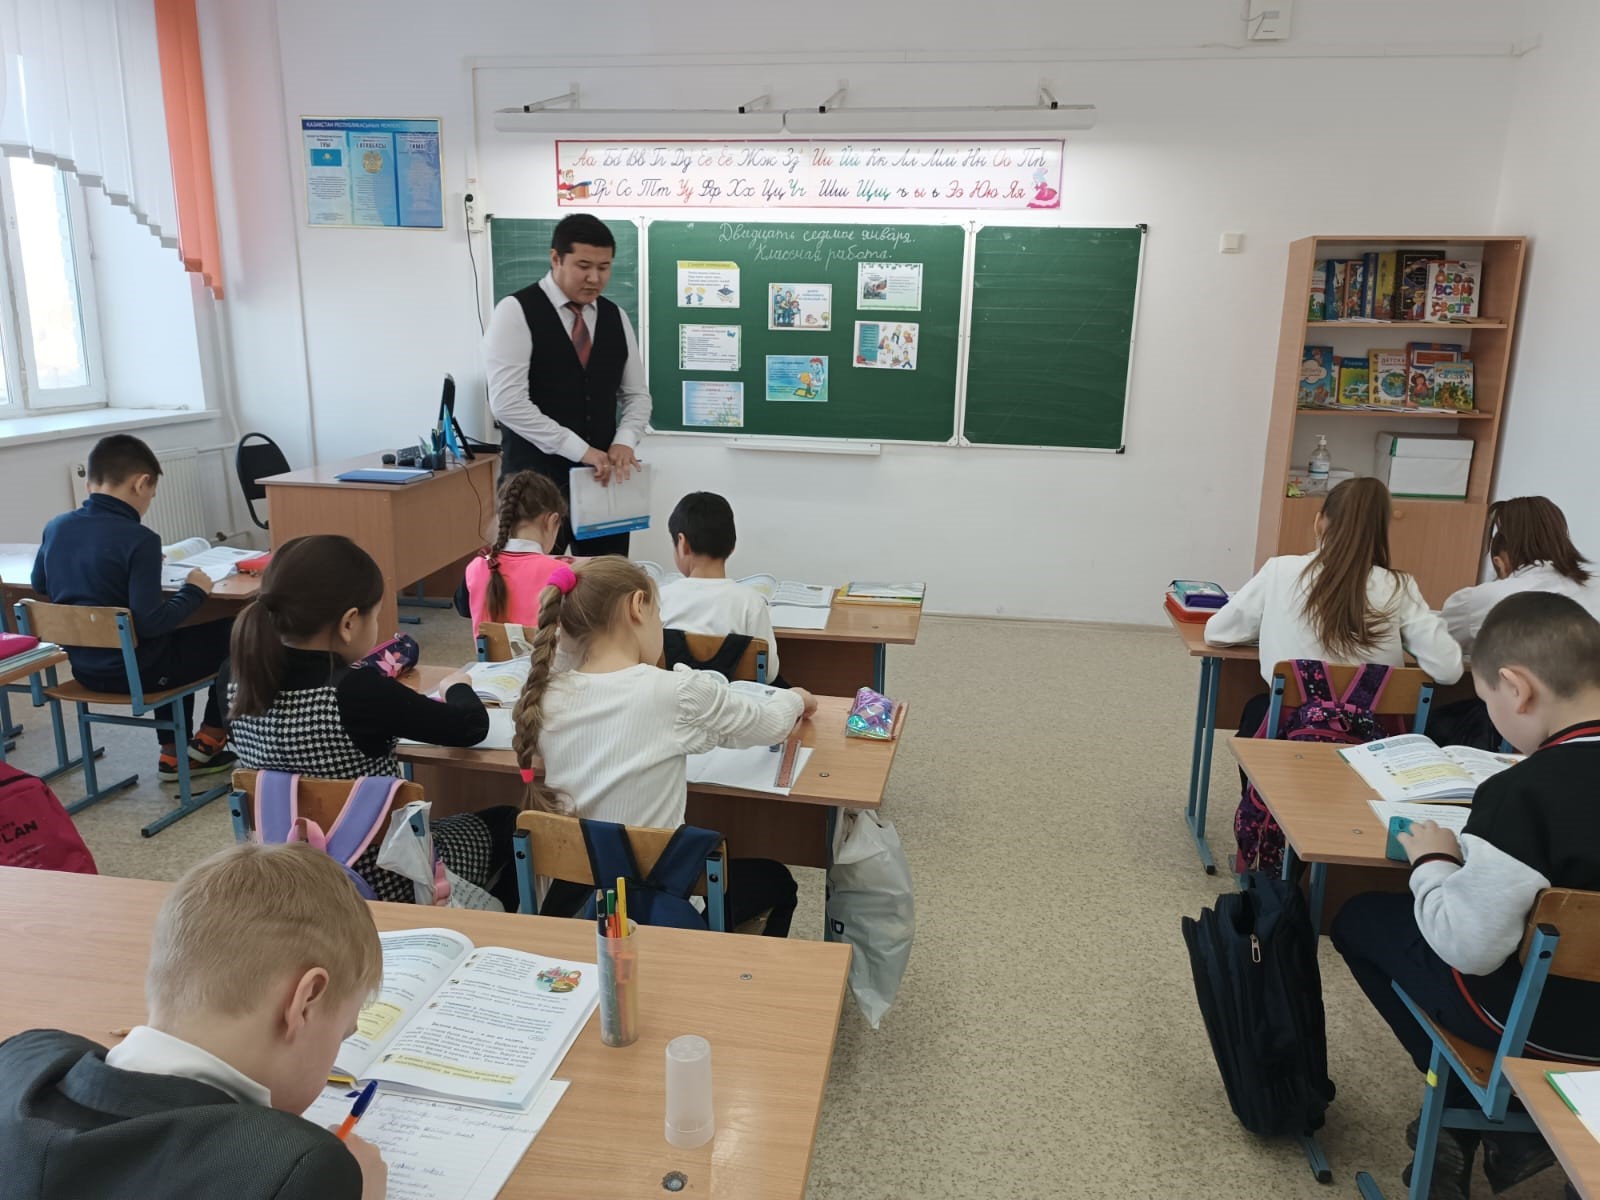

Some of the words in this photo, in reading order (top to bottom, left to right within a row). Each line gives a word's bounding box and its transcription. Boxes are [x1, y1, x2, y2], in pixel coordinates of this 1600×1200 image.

[572, 148, 597, 167] Аа
[603, 148, 628, 166] Бб
[626, 148, 646, 167] Вв
[650, 147, 667, 167] Гг
[670, 148, 692, 173] Дд
[697, 148, 713, 167] Ее
[737, 148, 777, 167] Жж
[782, 147, 800, 173] Зз
[811, 147, 833, 167] Ии
[839, 145, 860, 167] Йй
[865, 147, 888, 167] Кк
[891, 147, 917, 167] Лл
[921, 147, 957, 167] Мм
[961, 147, 988, 167] Нн
[992, 147, 1012, 168] Оо
[1017, 147, 1048, 168] Пп
[590, 178, 610, 203] Рр
[616, 178, 632, 196] Сс
[637, 178, 671, 197] Тт
[676, 178, 694, 203] Уу
[698, 179, 722, 203] Фф
[726, 178, 755, 197] Хх
[760, 178, 786, 201] Цц
[788, 178, 806, 197] Чч
[818, 179, 850, 198] Шш
[856, 179, 891, 202] Щщ
[897, 183, 908, 198] ъ
[914, 188, 927, 198] ы
[932, 187, 941, 198] ь
[945, 180, 965, 198] Ээ
[968, 180, 998, 199] Юю
[1002, 180, 1026, 199] Яя
[719, 222, 795, 248] Двадцать
